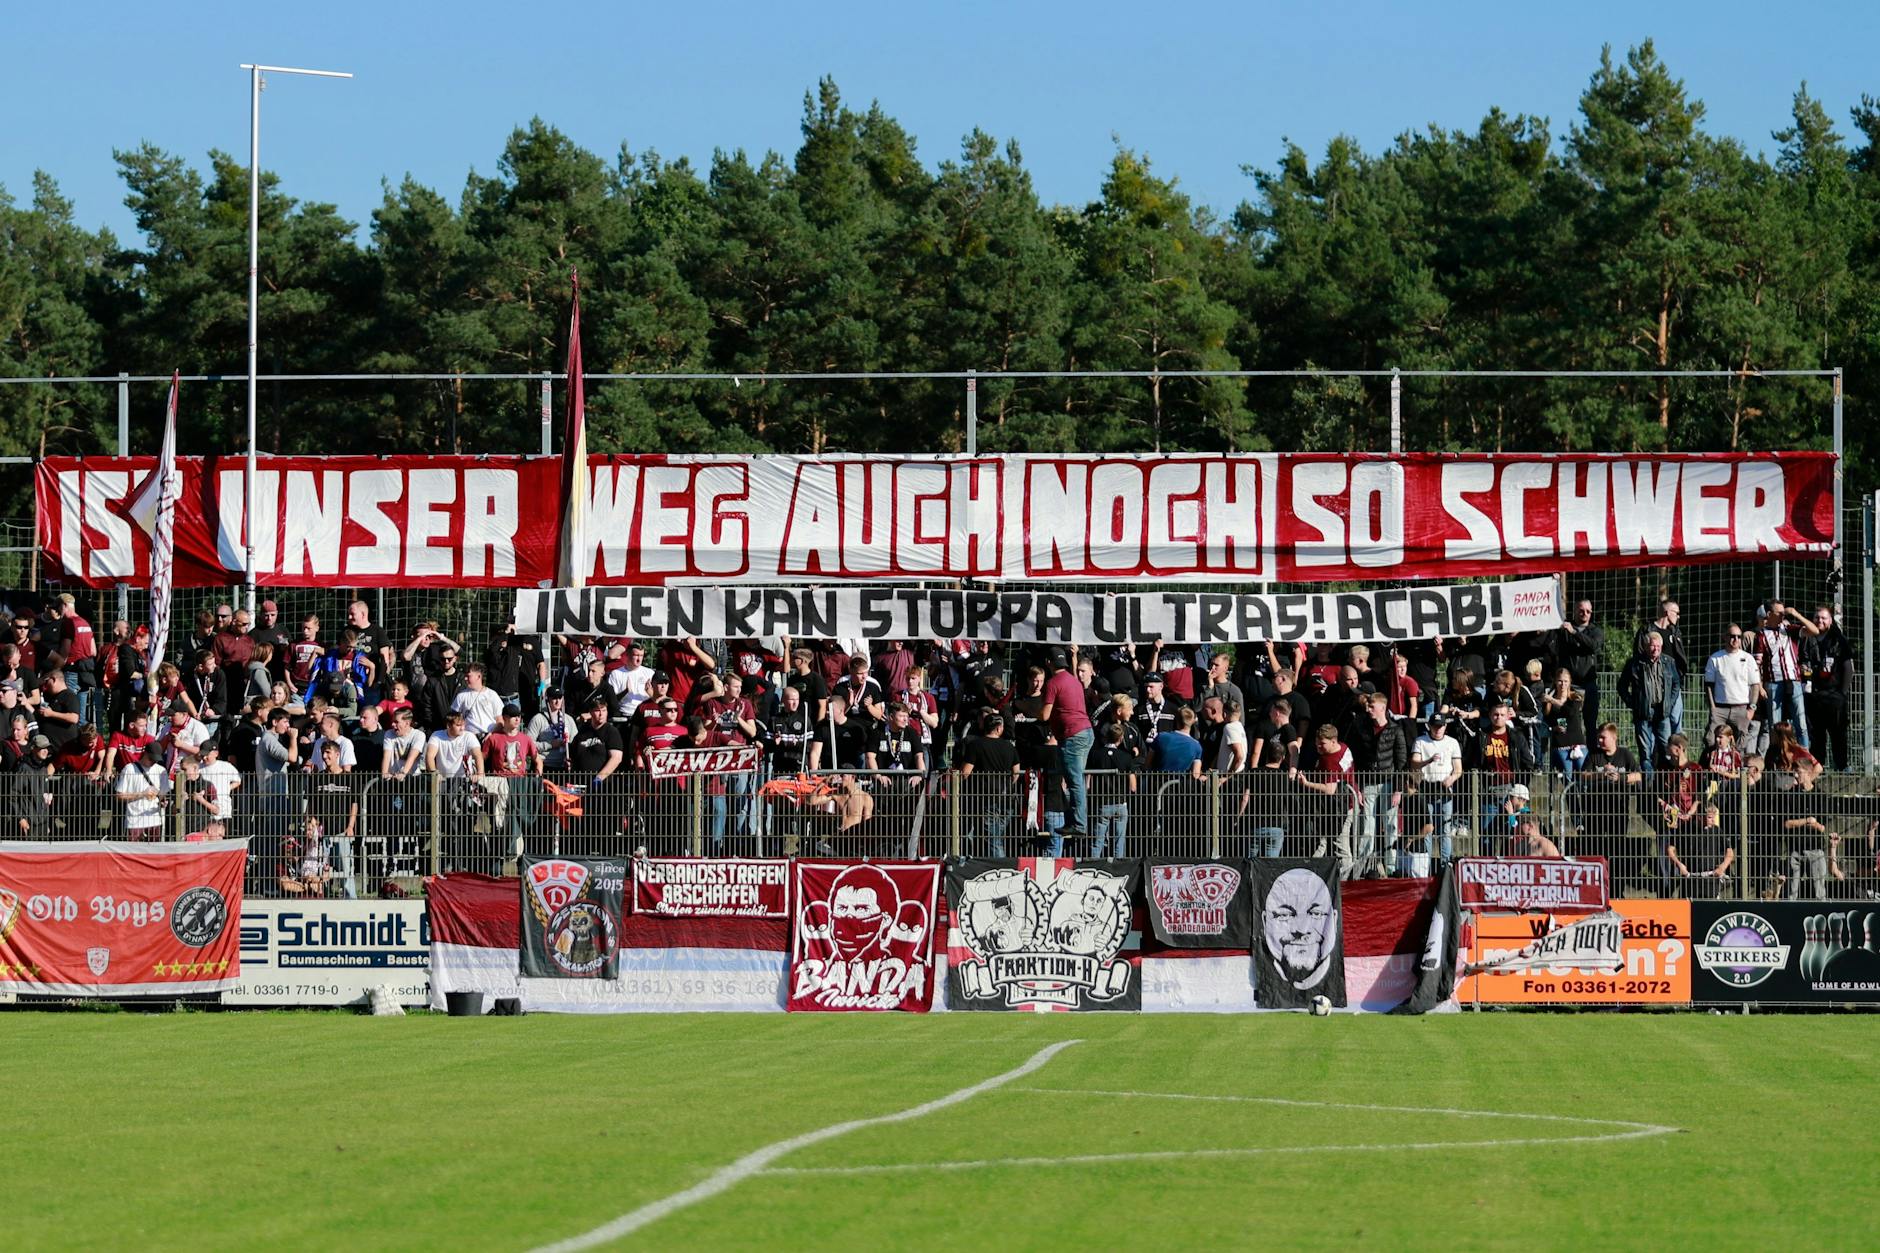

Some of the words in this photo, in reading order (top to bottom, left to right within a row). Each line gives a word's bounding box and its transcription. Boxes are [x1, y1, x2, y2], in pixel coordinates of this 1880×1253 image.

[218, 469, 518, 578] UNSER
[585, 464, 749, 577] WEG
[785, 462, 996, 572] AUCH
[1029, 462, 1257, 571] NOCH
[1292, 461, 1404, 568] SO
[1513, 590, 1550, 605] BANDA
[536, 586, 704, 637] INGEN
[724, 588, 837, 637] KAN
[860, 589, 1072, 642] STOPPA
[1093, 593, 1325, 642] ULTRAS!
[1338, 584, 1504, 640] ACAB!
[1513, 605, 1551, 618] INVICTA
[531, 863, 584, 883] BFC
[594, 863, 625, 875] since
[637, 862, 785, 885] VERBANDSSTRAFEN
[1196, 868, 1233, 884] BFC
[1463, 863, 1534, 884] AUSBAU
[1539, 864, 1600, 885] JETZT!
[594, 879, 624, 893] 2015
[662, 884, 759, 904] ABSCHAFFEN
[1484, 884, 1580, 903] SPORTFORUM
[27, 894, 78, 922] Old
[91, 895, 166, 928] Boys
[1164, 908, 1224, 925] SEKTION
[1709, 916, 1775, 944] BOWLING
[281, 955, 371, 965] Baumaschinen
[1704, 951, 1780, 963] STRIKERS
[994, 956, 1093, 983] FRAKTION-H
[1734, 973, 1750, 984] 2.0
[792, 957, 925, 1001] BANDA
[1524, 981, 1555, 993] Fon
[1562, 981, 1671, 994] 03361-2072
[254, 985, 290, 995] 03361
[296, 985, 339, 995] 7719-0
